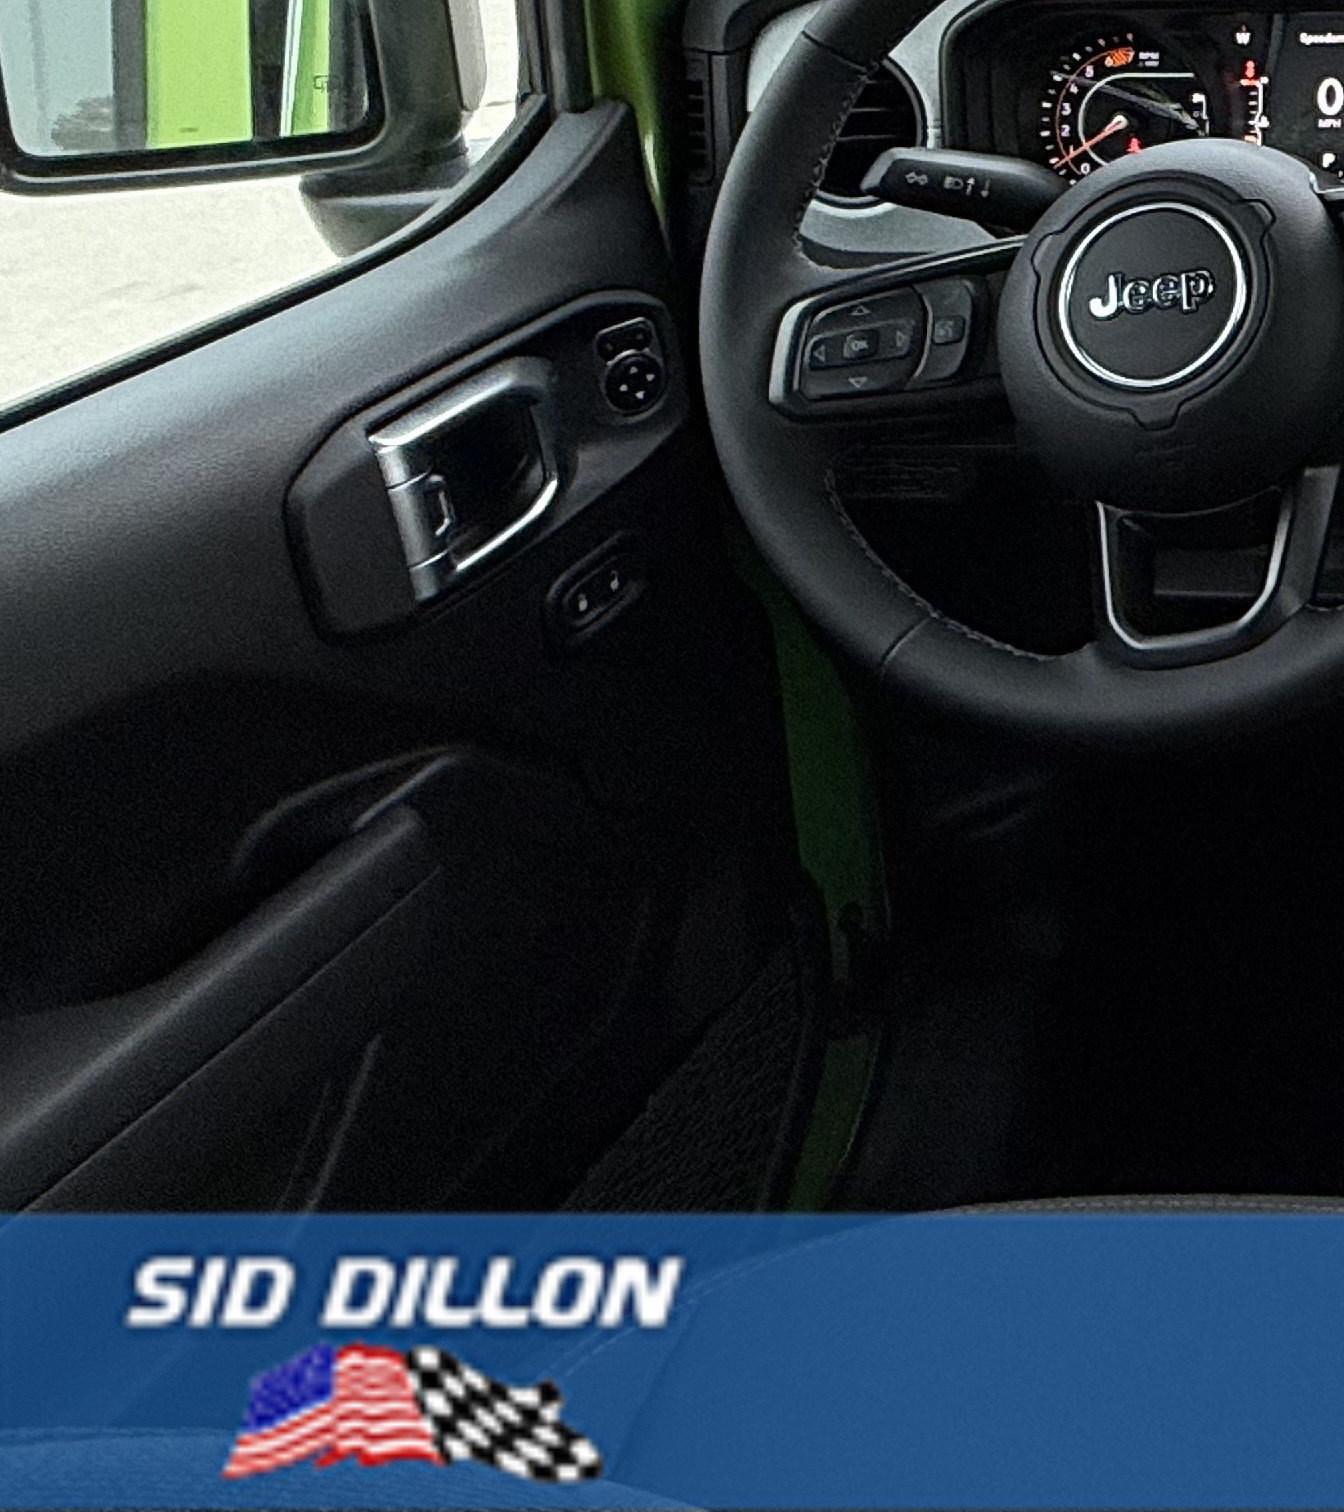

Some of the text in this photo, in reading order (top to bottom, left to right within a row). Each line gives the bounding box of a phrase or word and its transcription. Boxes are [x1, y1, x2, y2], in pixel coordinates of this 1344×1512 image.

[1061, 103, 1071, 116] 3
[1318, 119, 1342, 128] MPH
[1060, 125, 1070, 137] 2
[1081, 163, 1090, 174] 0
[1089, 270, 1214, 319] Jeep
